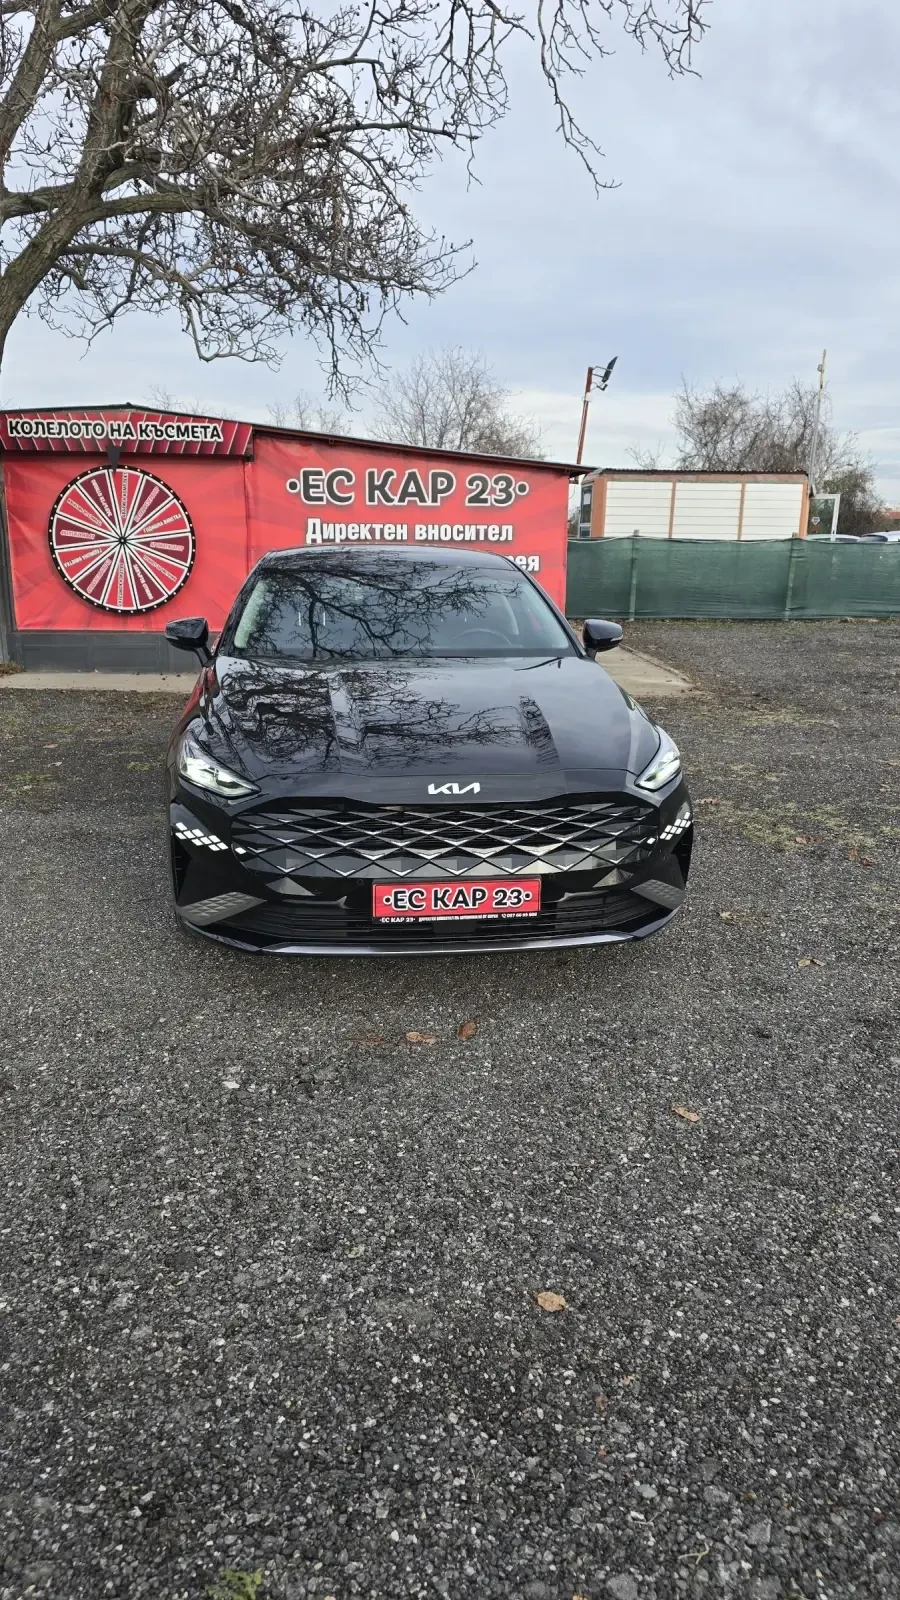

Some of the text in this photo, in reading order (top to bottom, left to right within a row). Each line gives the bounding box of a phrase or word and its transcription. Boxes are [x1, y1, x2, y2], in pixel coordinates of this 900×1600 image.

[8, 418, 223, 442] КОЛЕЛОТО НА КЪСМЕТА
[366, 468, 456, 506] КАР
[306, 518, 513, 544] Директен вносител
[432, 887, 488, 910] КАР
